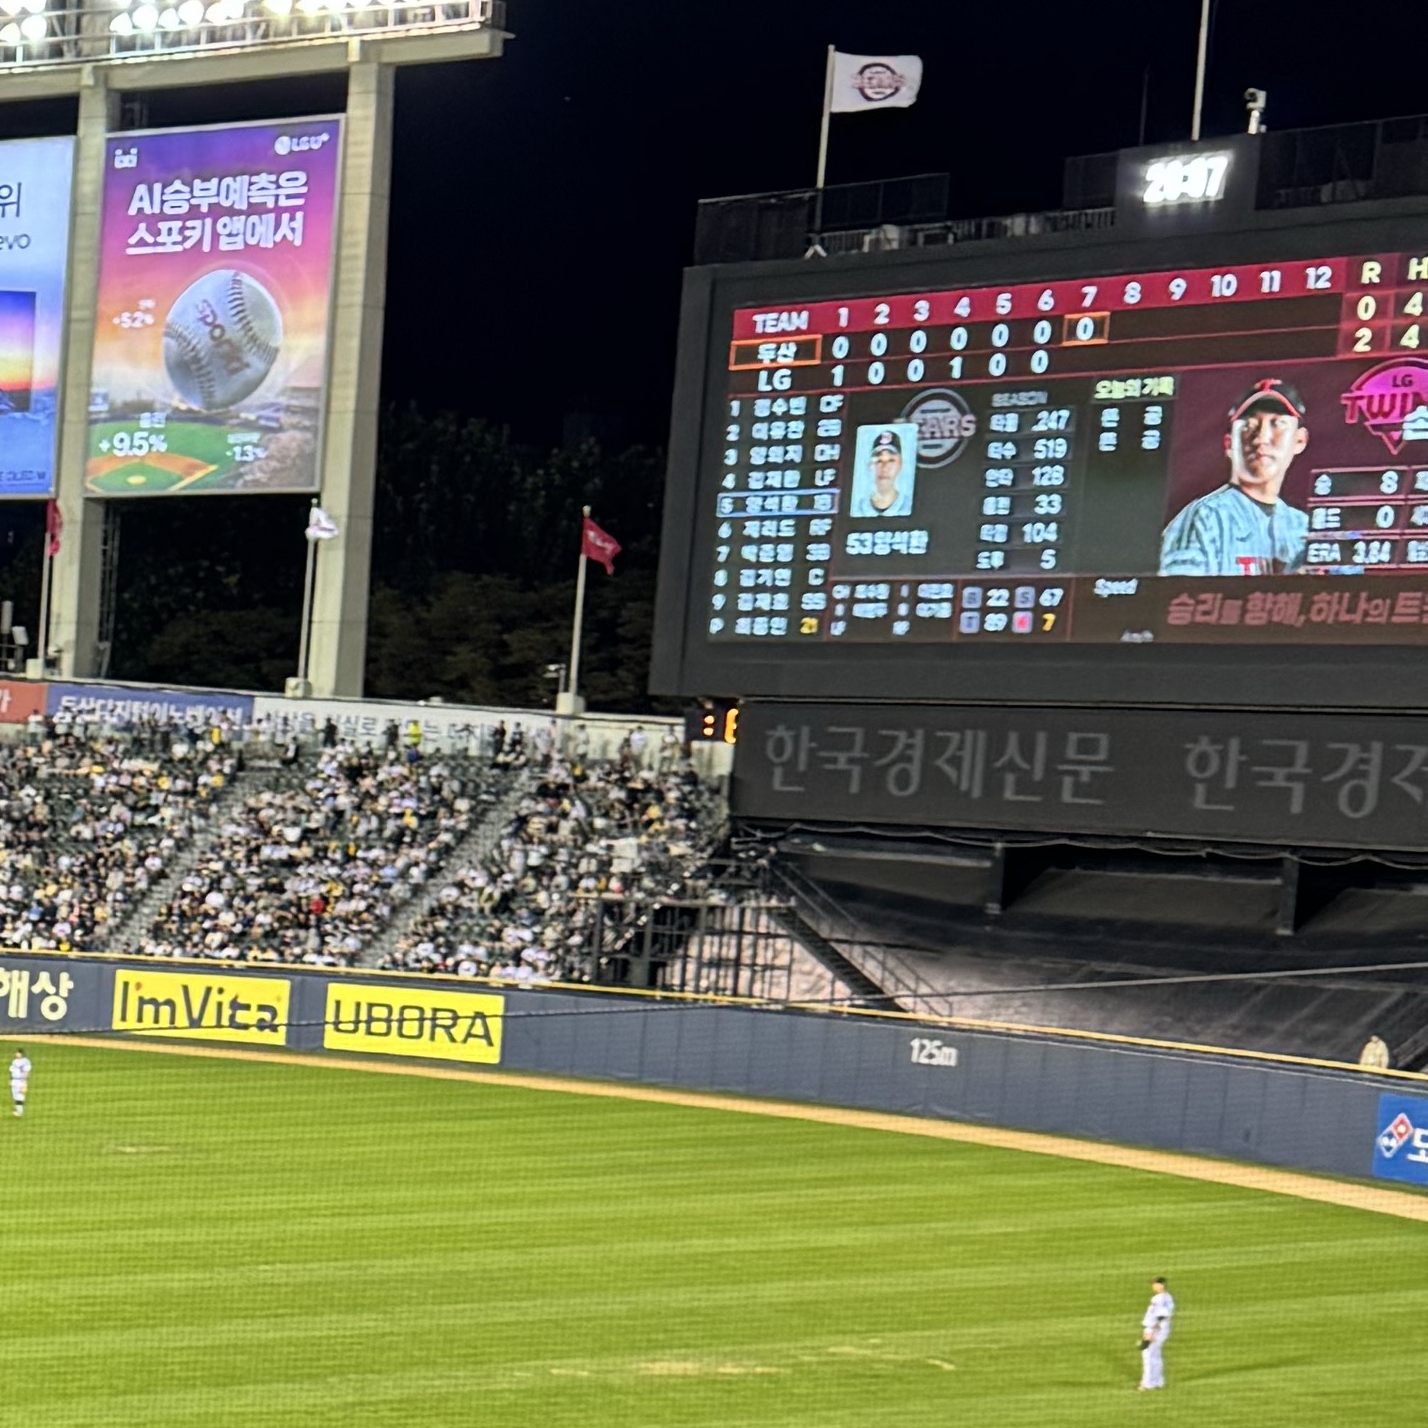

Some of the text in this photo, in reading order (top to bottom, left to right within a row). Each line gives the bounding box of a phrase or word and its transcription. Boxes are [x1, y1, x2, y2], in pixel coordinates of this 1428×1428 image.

[127, 170, 309, 216] AI승부예측은
[125, 211, 305, 256] 스포키 앱에서
[752, 256, 1428, 333] TEAM 1 2 3 4 5 6 7 8 9 10 11 12 R H
[831, 335, 850, 360] 0
[870, 332, 888, 357] 0
[909, 329, 928, 354] 0
[949, 326, 968, 351] 0
[991, 323, 1010, 348] 0
[1033, 320, 1052, 345] 0
[1075, 316, 1095, 342] 0
[1356, 295, 1377, 321] 0
[1403, 291, 1424, 316] 4
[757, 323, 1420, 392] LG 1 0 0 1 0 0 2 4
[1391, 374, 1414, 388] LG
[1379, 470, 1399, 494] 8
[1033, 493, 1063, 515] 33
[1375, 505, 1395, 529] 0
[1021, 522, 1058, 543] 104
[1039, 548, 1057, 570] 5
[1306, 542, 1341, 564] ERA
[1392, 592, 1428, 624] 트
[764, 724, 1117, 806] 한국경제신문
[332, 998, 496, 1048] UBORA
[909, 1037, 958, 1068] 125m
